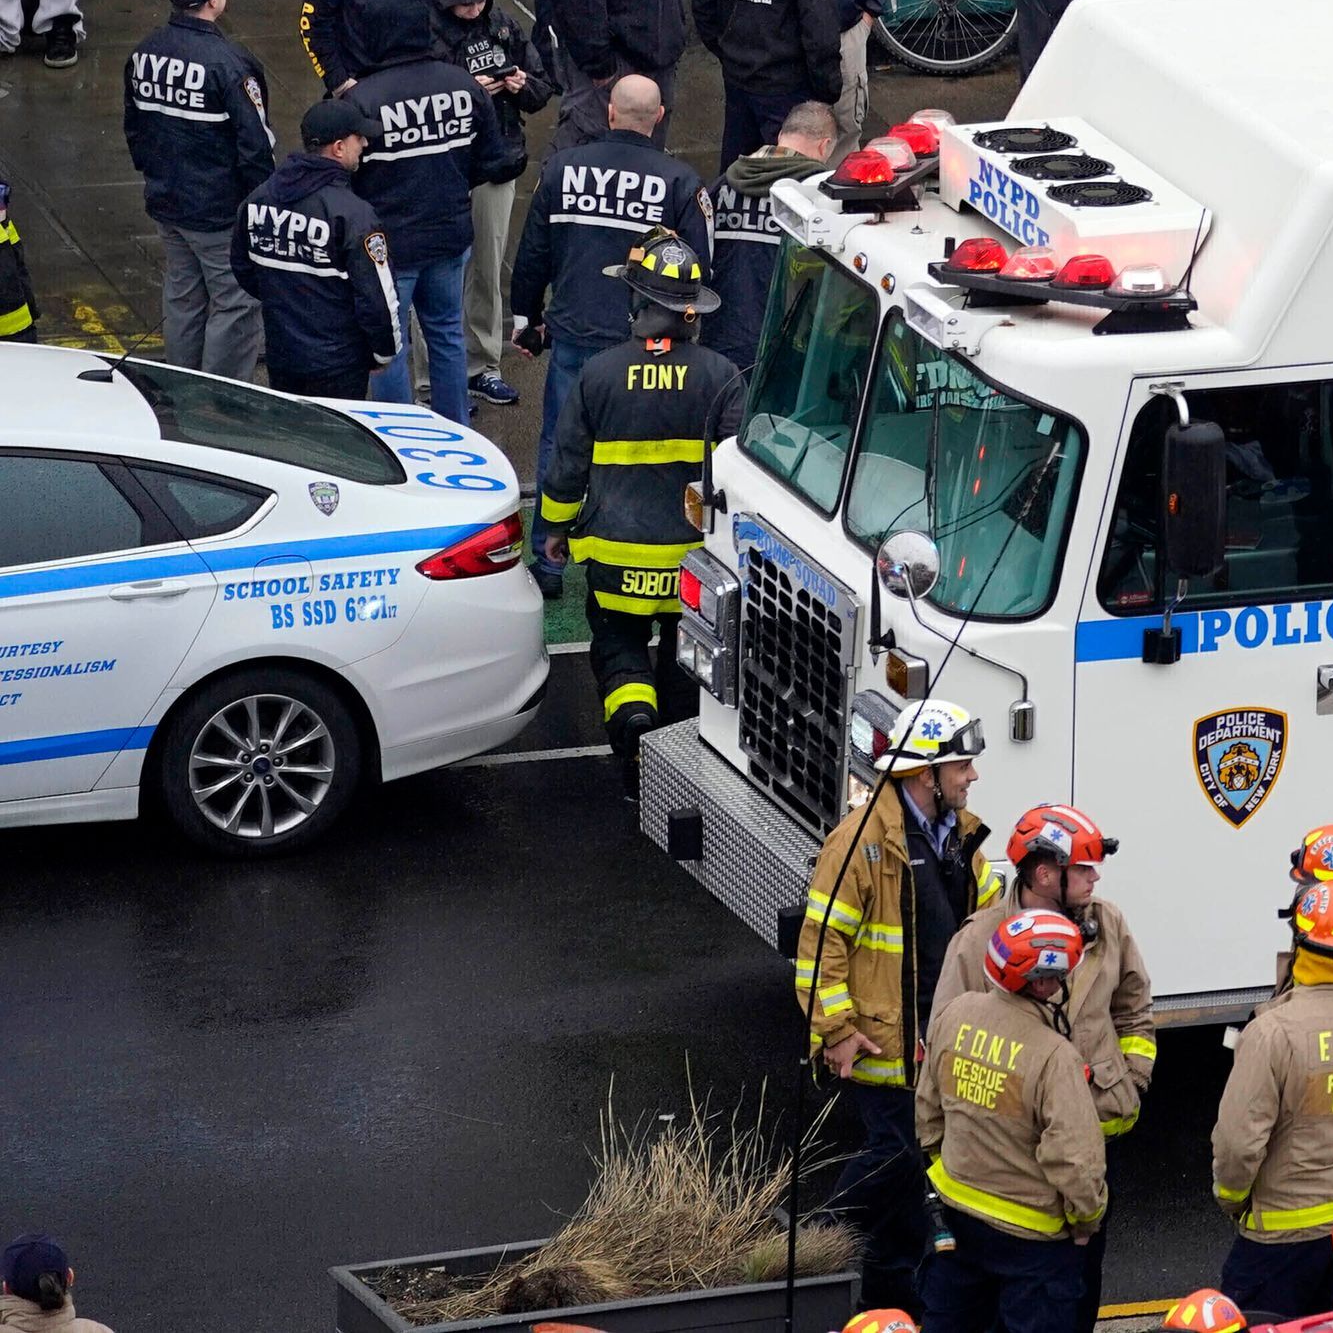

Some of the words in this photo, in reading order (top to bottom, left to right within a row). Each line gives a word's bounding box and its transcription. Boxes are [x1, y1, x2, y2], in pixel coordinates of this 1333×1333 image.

[131, 51, 206, 92] NYPD
[131, 79, 206, 109] POLICE
[380, 89, 474, 132] NYPD
[384, 117, 473, 148] POLICE
[562, 165, 667, 204] NYPD
[977, 156, 1040, 220] NYPD
[247, 203, 331, 247] NYPD
[562, 194, 665, 223] POLICE
[968, 177, 1051, 247] POLICE
[249, 232, 332, 264] POLICE
[627, 364, 688, 391] FDNY
[350, 408, 507, 492] 6301
[223, 577, 310, 602] SCHOOL
[319, 567, 401, 592] SAFETY
[271, 602, 295, 629] BS
[303, 598, 337, 627] SSD
[1216, 712, 1266, 730] POLICE
[1198, 724, 1282, 752] DEPARTMENT
[953, 1057, 1008, 1093] RESCUE
[955, 1081, 998, 1111] MEDIC
